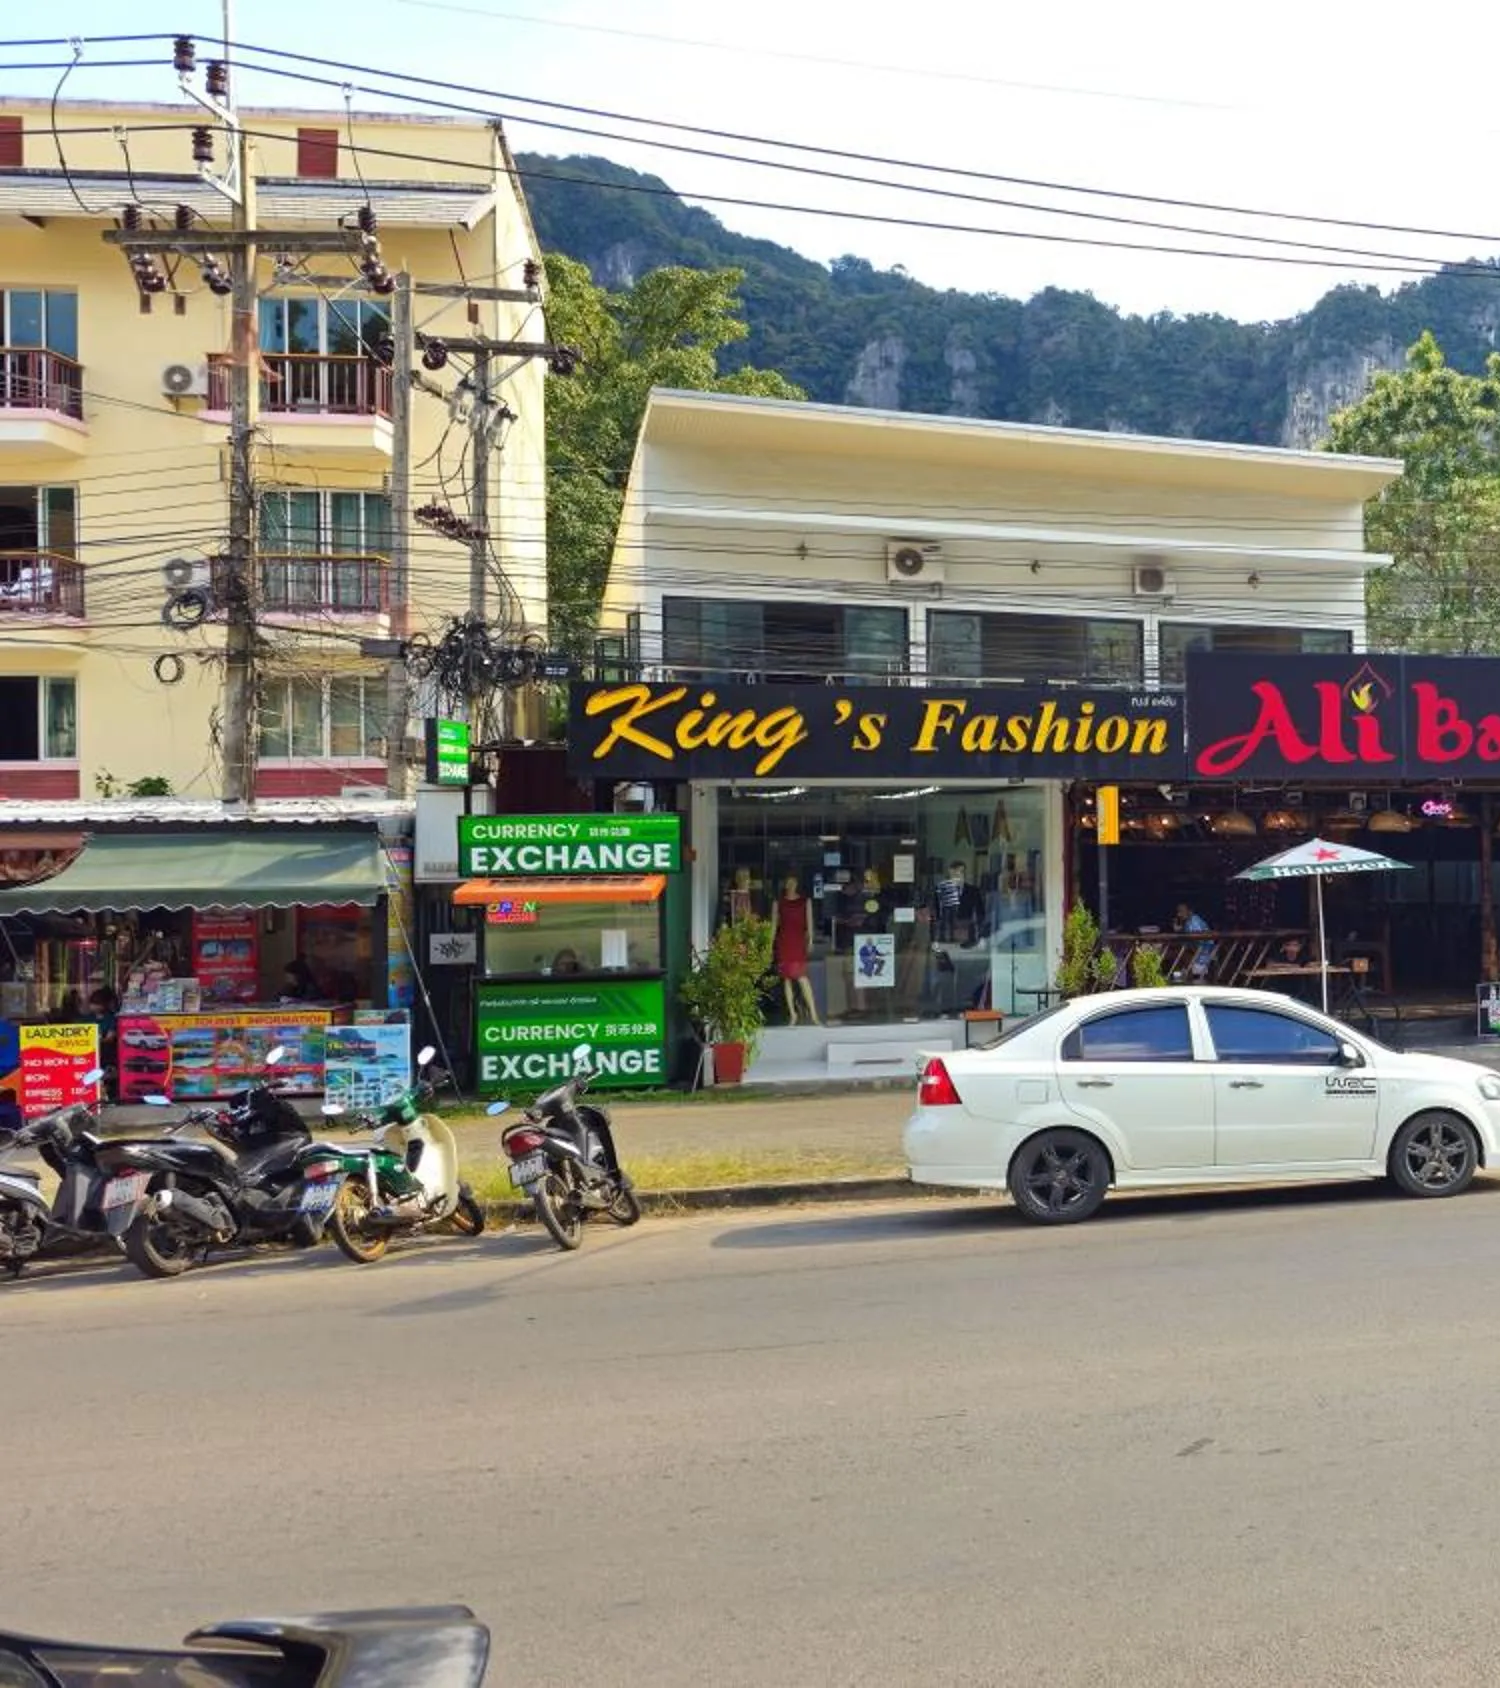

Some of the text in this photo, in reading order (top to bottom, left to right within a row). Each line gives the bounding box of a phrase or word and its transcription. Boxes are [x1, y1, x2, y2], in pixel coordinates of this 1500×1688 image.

[584, 682, 808, 777] King
[910, 699, 1169, 755] Fashion
[1195, 674, 1396, 776] Ali
[472, 823, 581, 839] CURRENCY
[470, 843, 672, 872] EXCHANGE
[1272, 860, 1394, 878] Heineken
[487, 901, 536, 912] OPEN
[26, 1026, 91, 1039] LAUNDRY
[485, 1023, 600, 1042] CURRENCY
[481, 1048, 661, 1081] EXCHANGE
